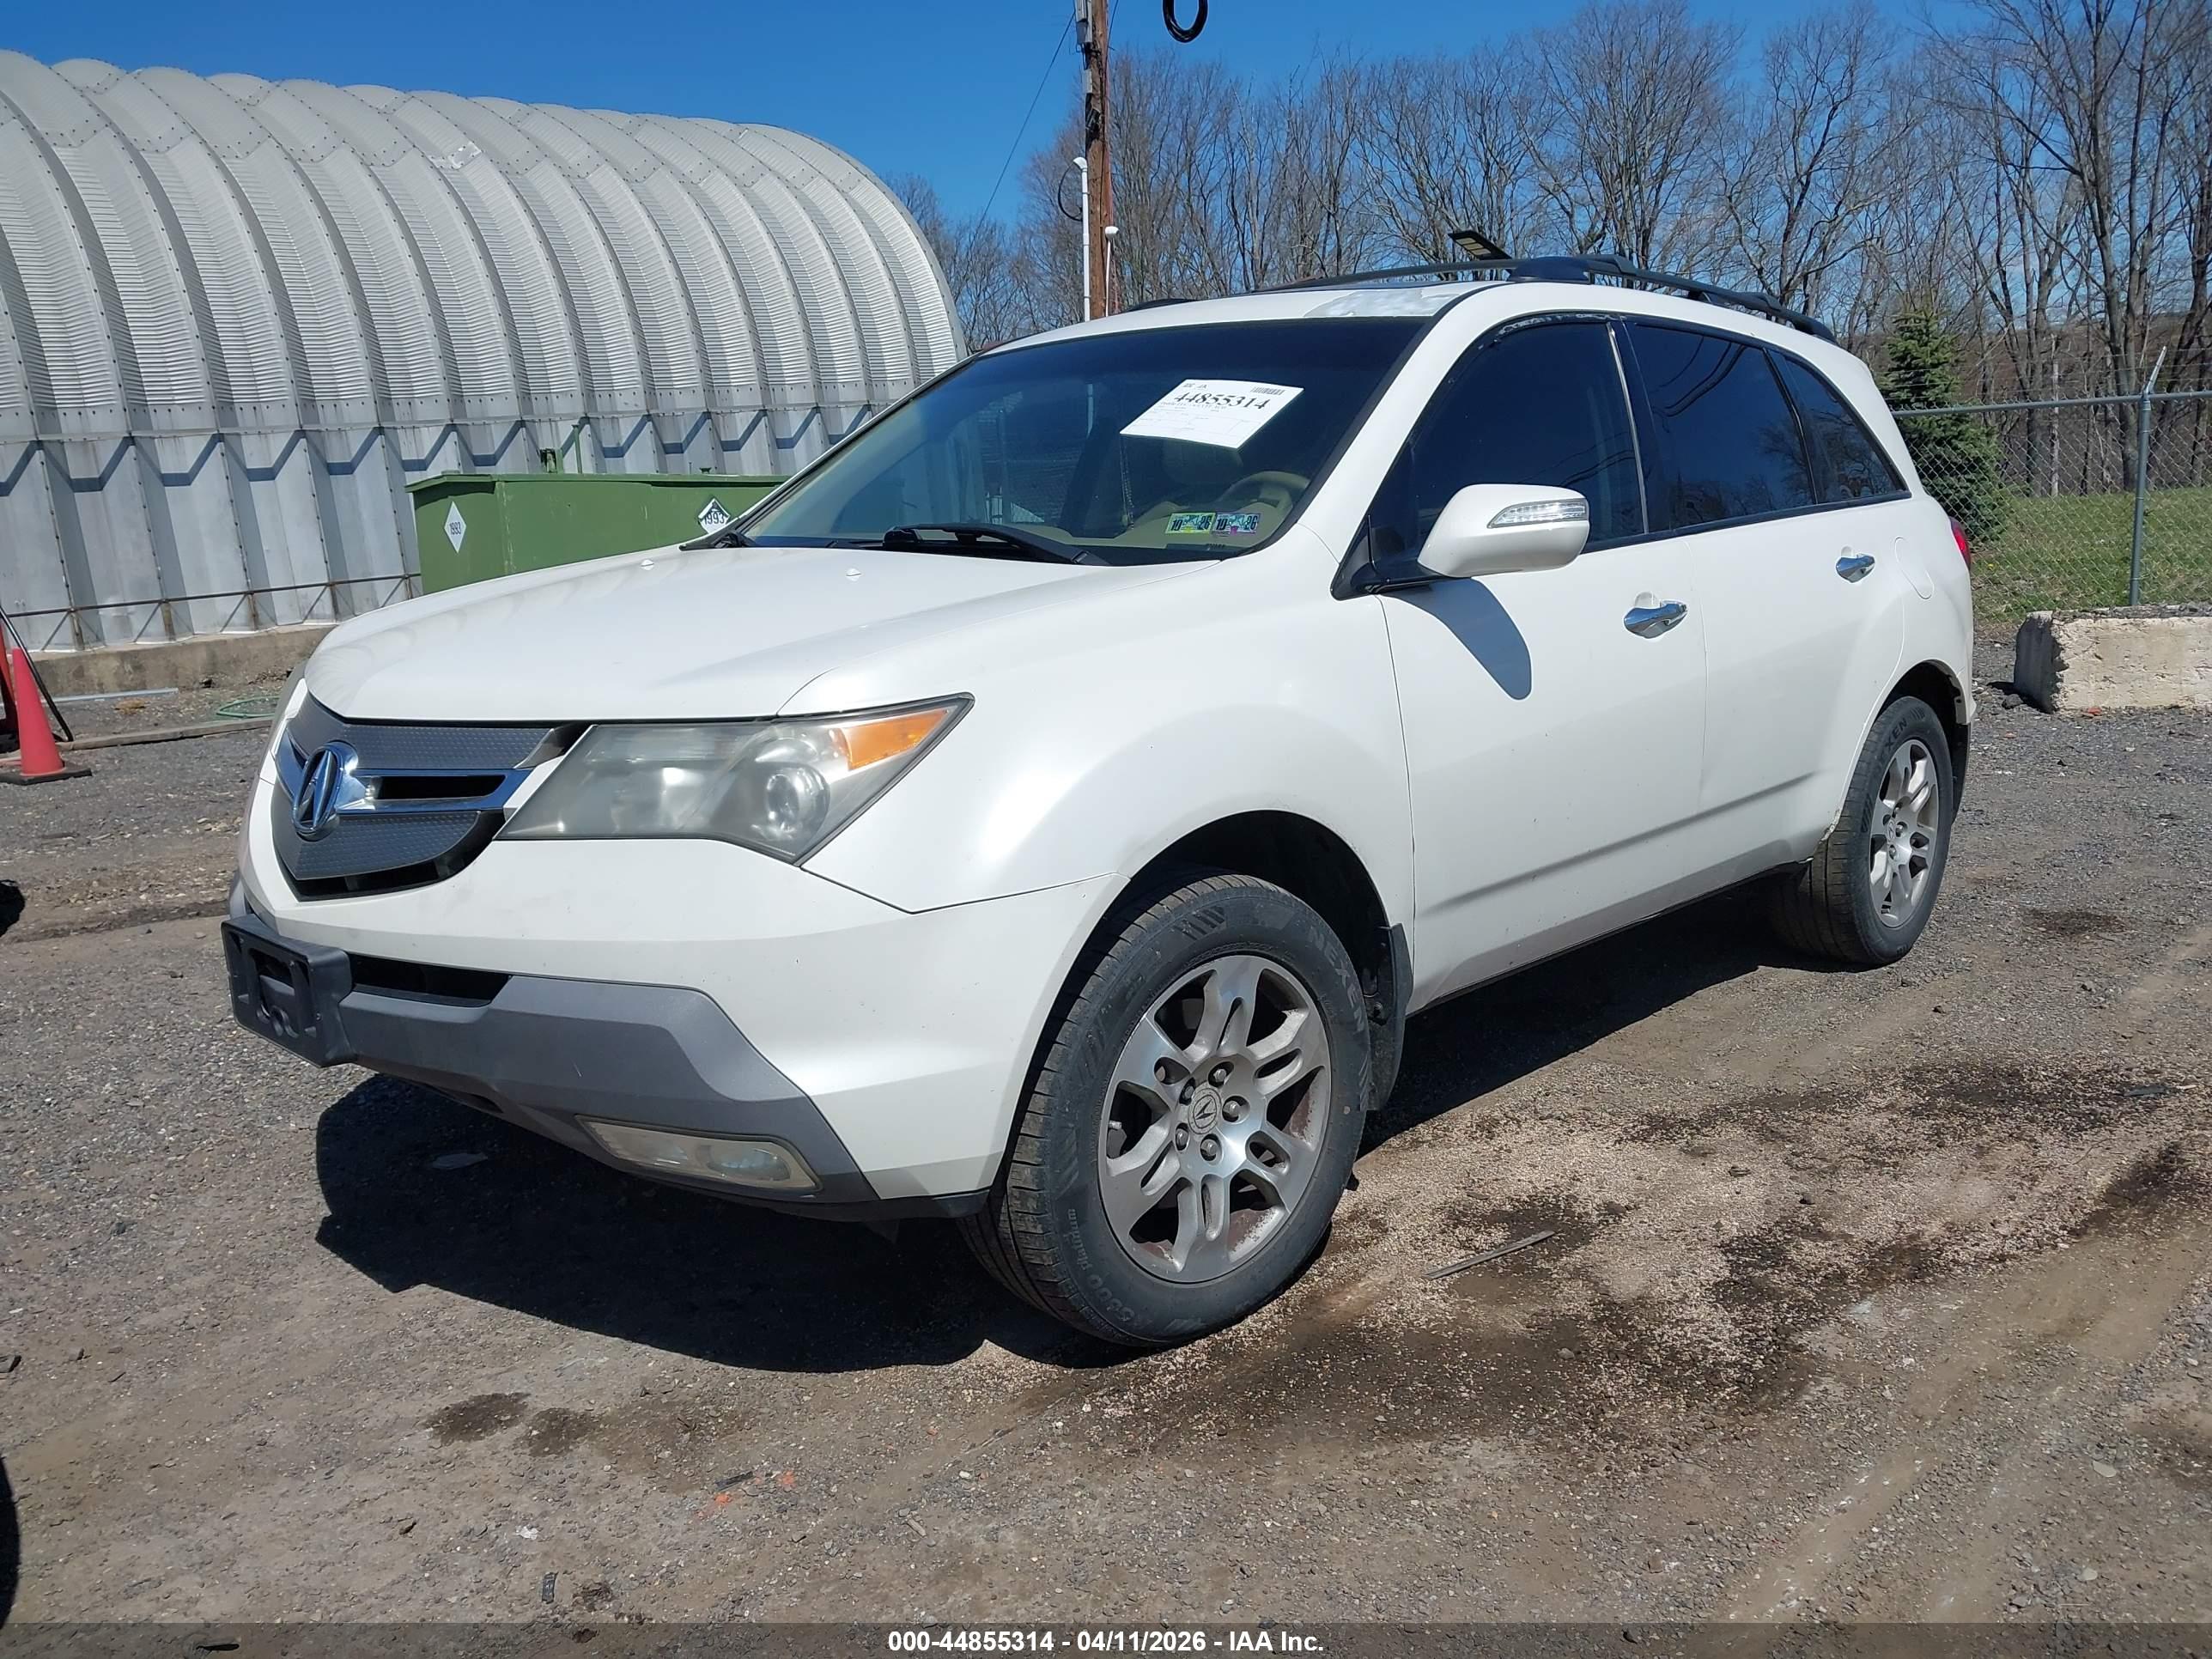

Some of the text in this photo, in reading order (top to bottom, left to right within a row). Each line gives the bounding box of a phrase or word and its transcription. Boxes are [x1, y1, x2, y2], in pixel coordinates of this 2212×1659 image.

[1174, 392, 1271, 410] 44855314
[705, 512, 725, 525] 1993
[1170, 515, 1212, 531] 10 26
[1216, 515, 1257, 531] 10 26
[1308, 926, 1365, 1032] NEXEN
